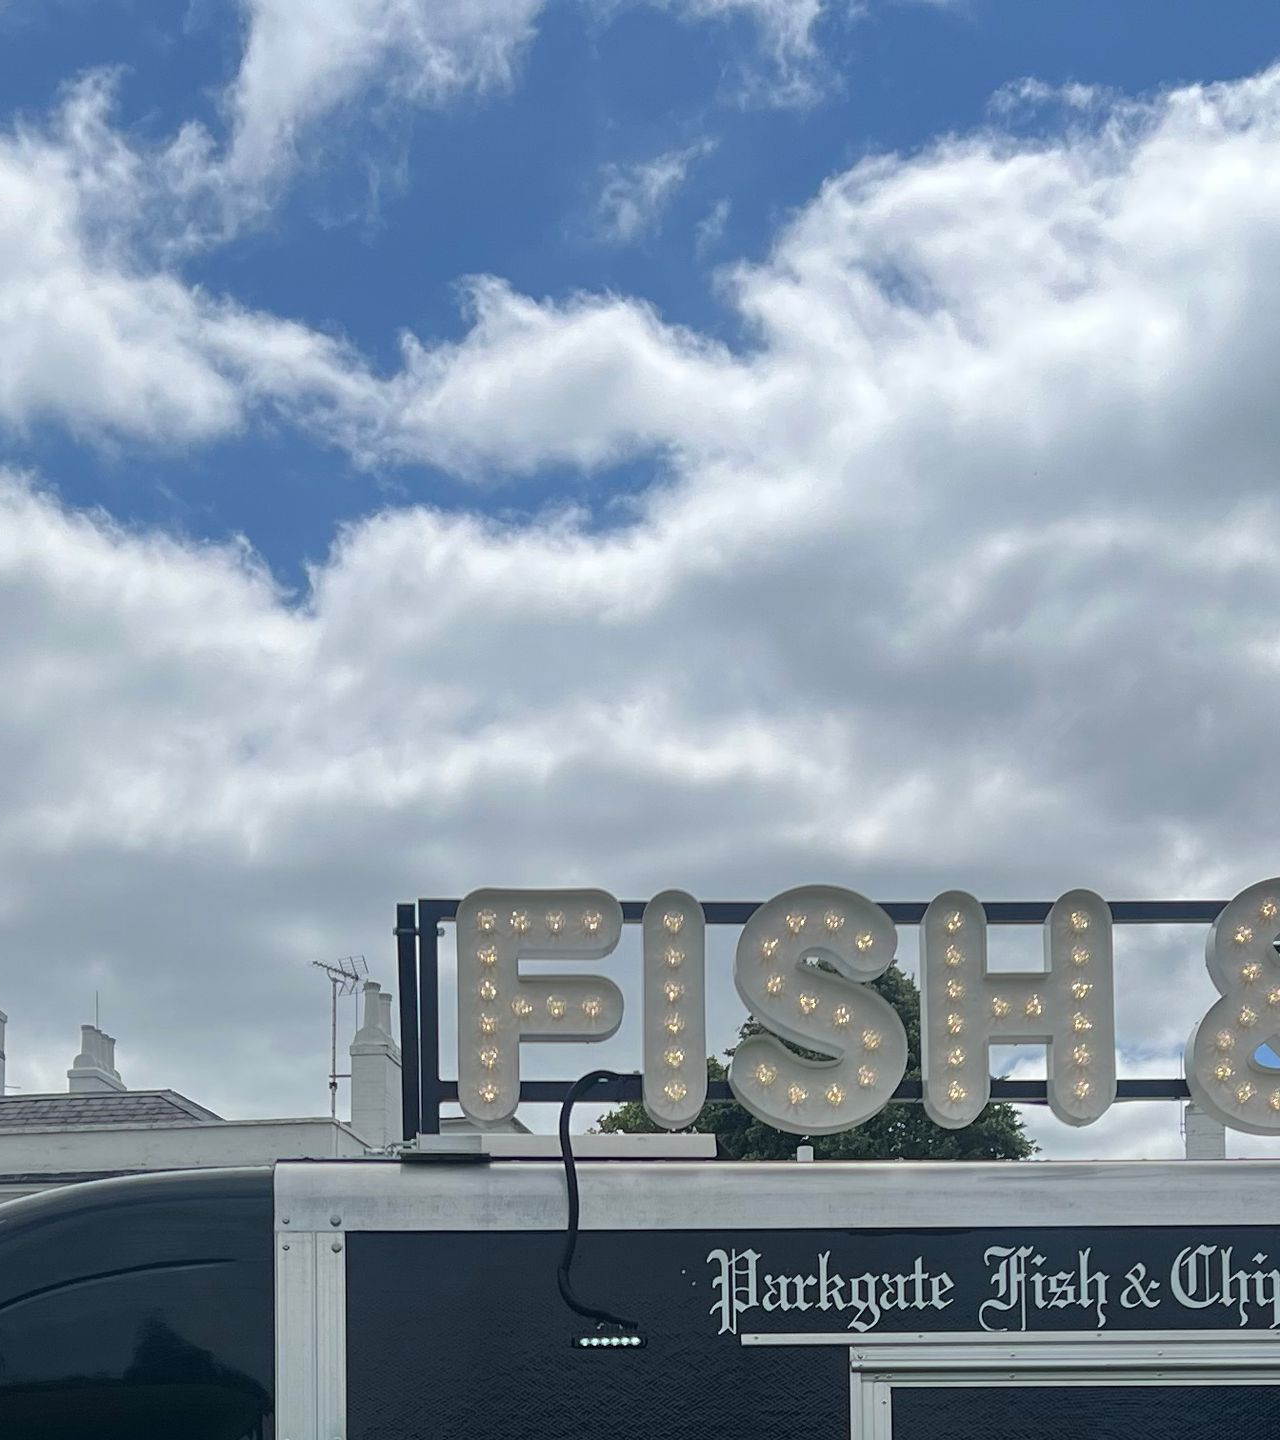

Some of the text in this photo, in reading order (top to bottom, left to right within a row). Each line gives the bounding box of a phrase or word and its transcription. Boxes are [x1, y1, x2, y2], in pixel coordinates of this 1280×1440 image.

[457, 883, 1115, 1135] FISH
[706, 1248, 955, 1335] Parkgate
[979, 1246, 1111, 1331] Fish
[1120, 1262, 1161, 1309] &
